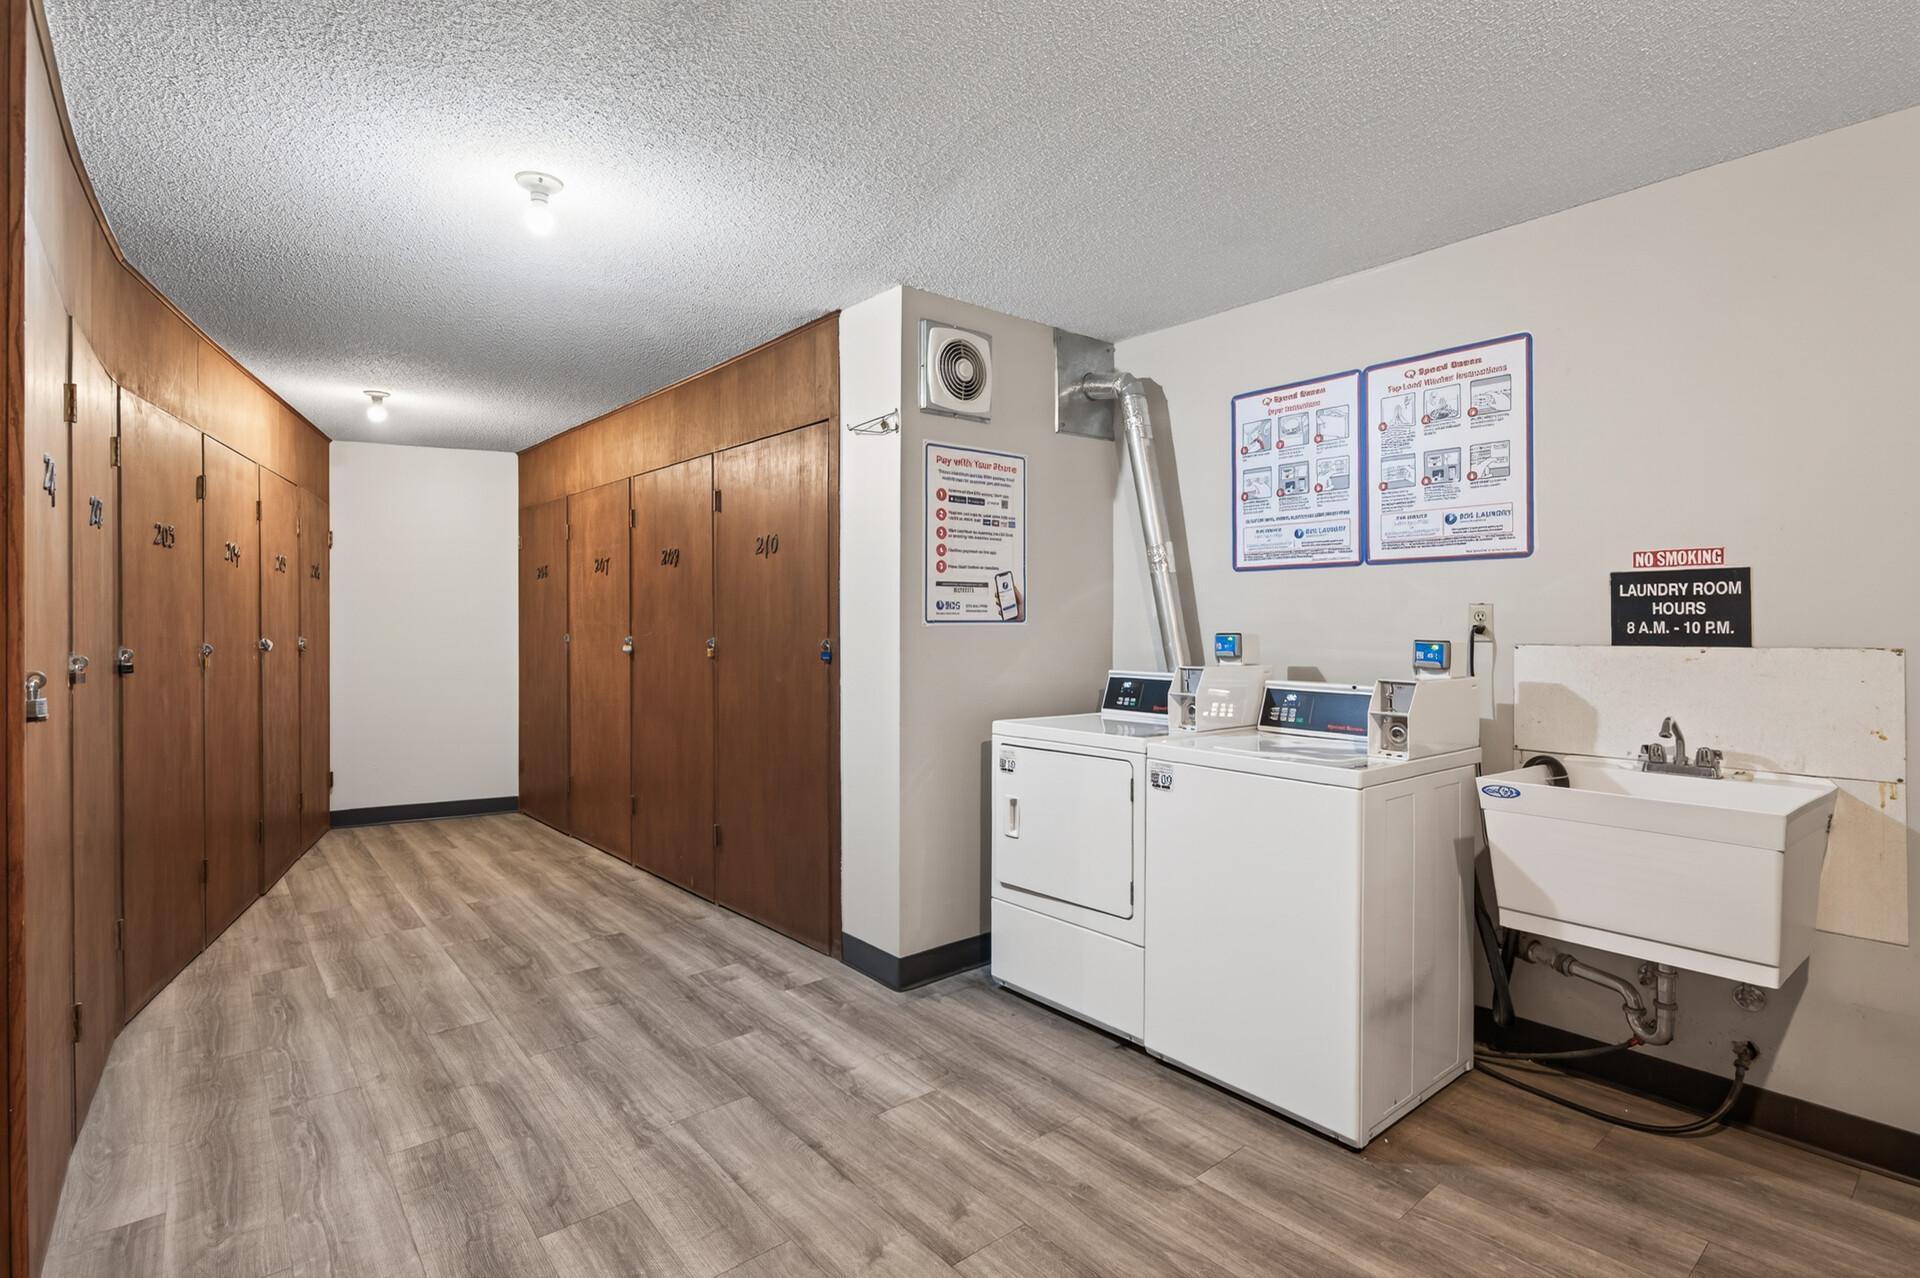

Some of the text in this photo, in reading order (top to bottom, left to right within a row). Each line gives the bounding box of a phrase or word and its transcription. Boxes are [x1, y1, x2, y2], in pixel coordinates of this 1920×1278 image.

[936, 455, 952, 467] Pay
[953, 457, 973, 468] with
[975, 460, 992, 470] Your
[755, 534, 779, 560] 210
[1635, 549, 1722, 567] NO SMOKING
[1619, 581, 1742, 597] LAUNDRY ROOM
[1652, 601, 1706, 615] HOURS
[1626, 621, 1635, 634] 8
[1638, 621, 1670, 634] A.M.
[1684, 621, 1701, 634] 10
[1705, 621, 1735, 634] P.M.
